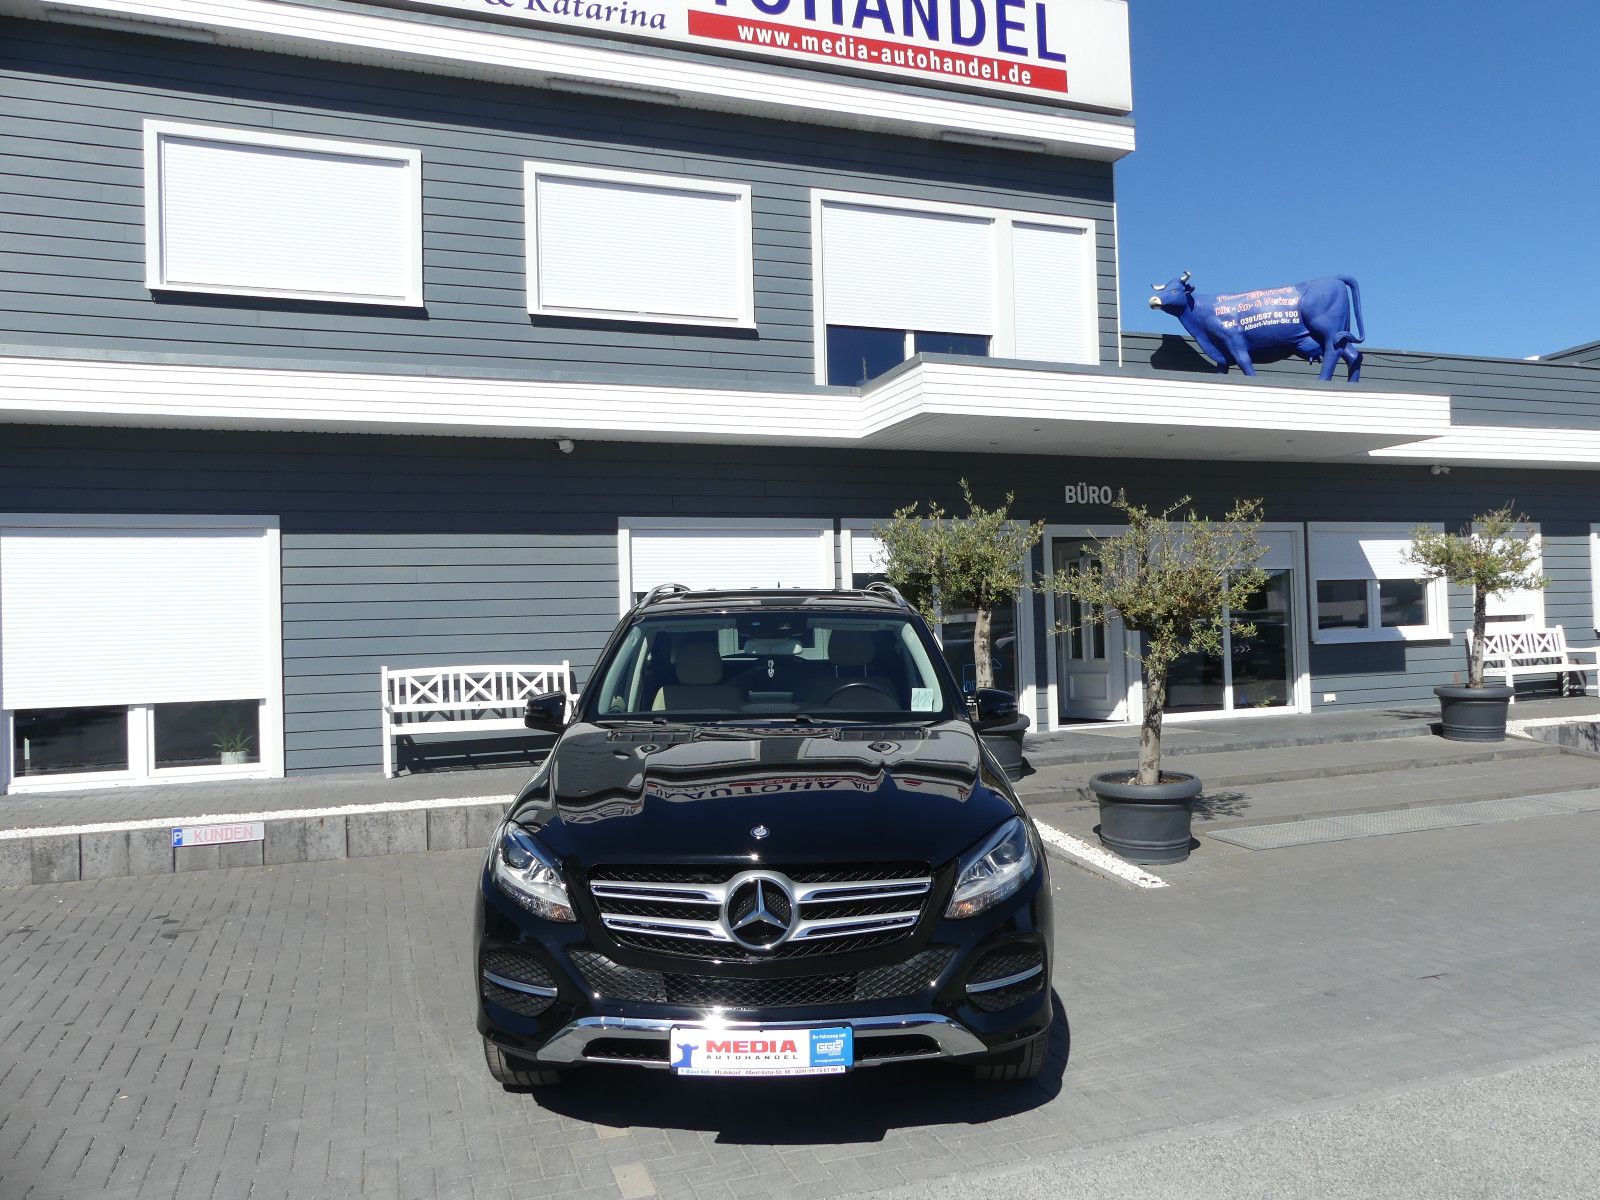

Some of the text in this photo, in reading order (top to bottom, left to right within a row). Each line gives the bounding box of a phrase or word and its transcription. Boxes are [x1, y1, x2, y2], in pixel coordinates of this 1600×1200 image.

[737, 23, 1032, 85] www.media-autohandel.de
[1223, 320, 1237, 328] Tel.
[1240, 312, 1272, 326] 0391/597
[1064, 482, 1112, 504] BÜRO
[193, 824, 253, 843] KUNDEN
[706, 1040, 797, 1053] MEDIA
